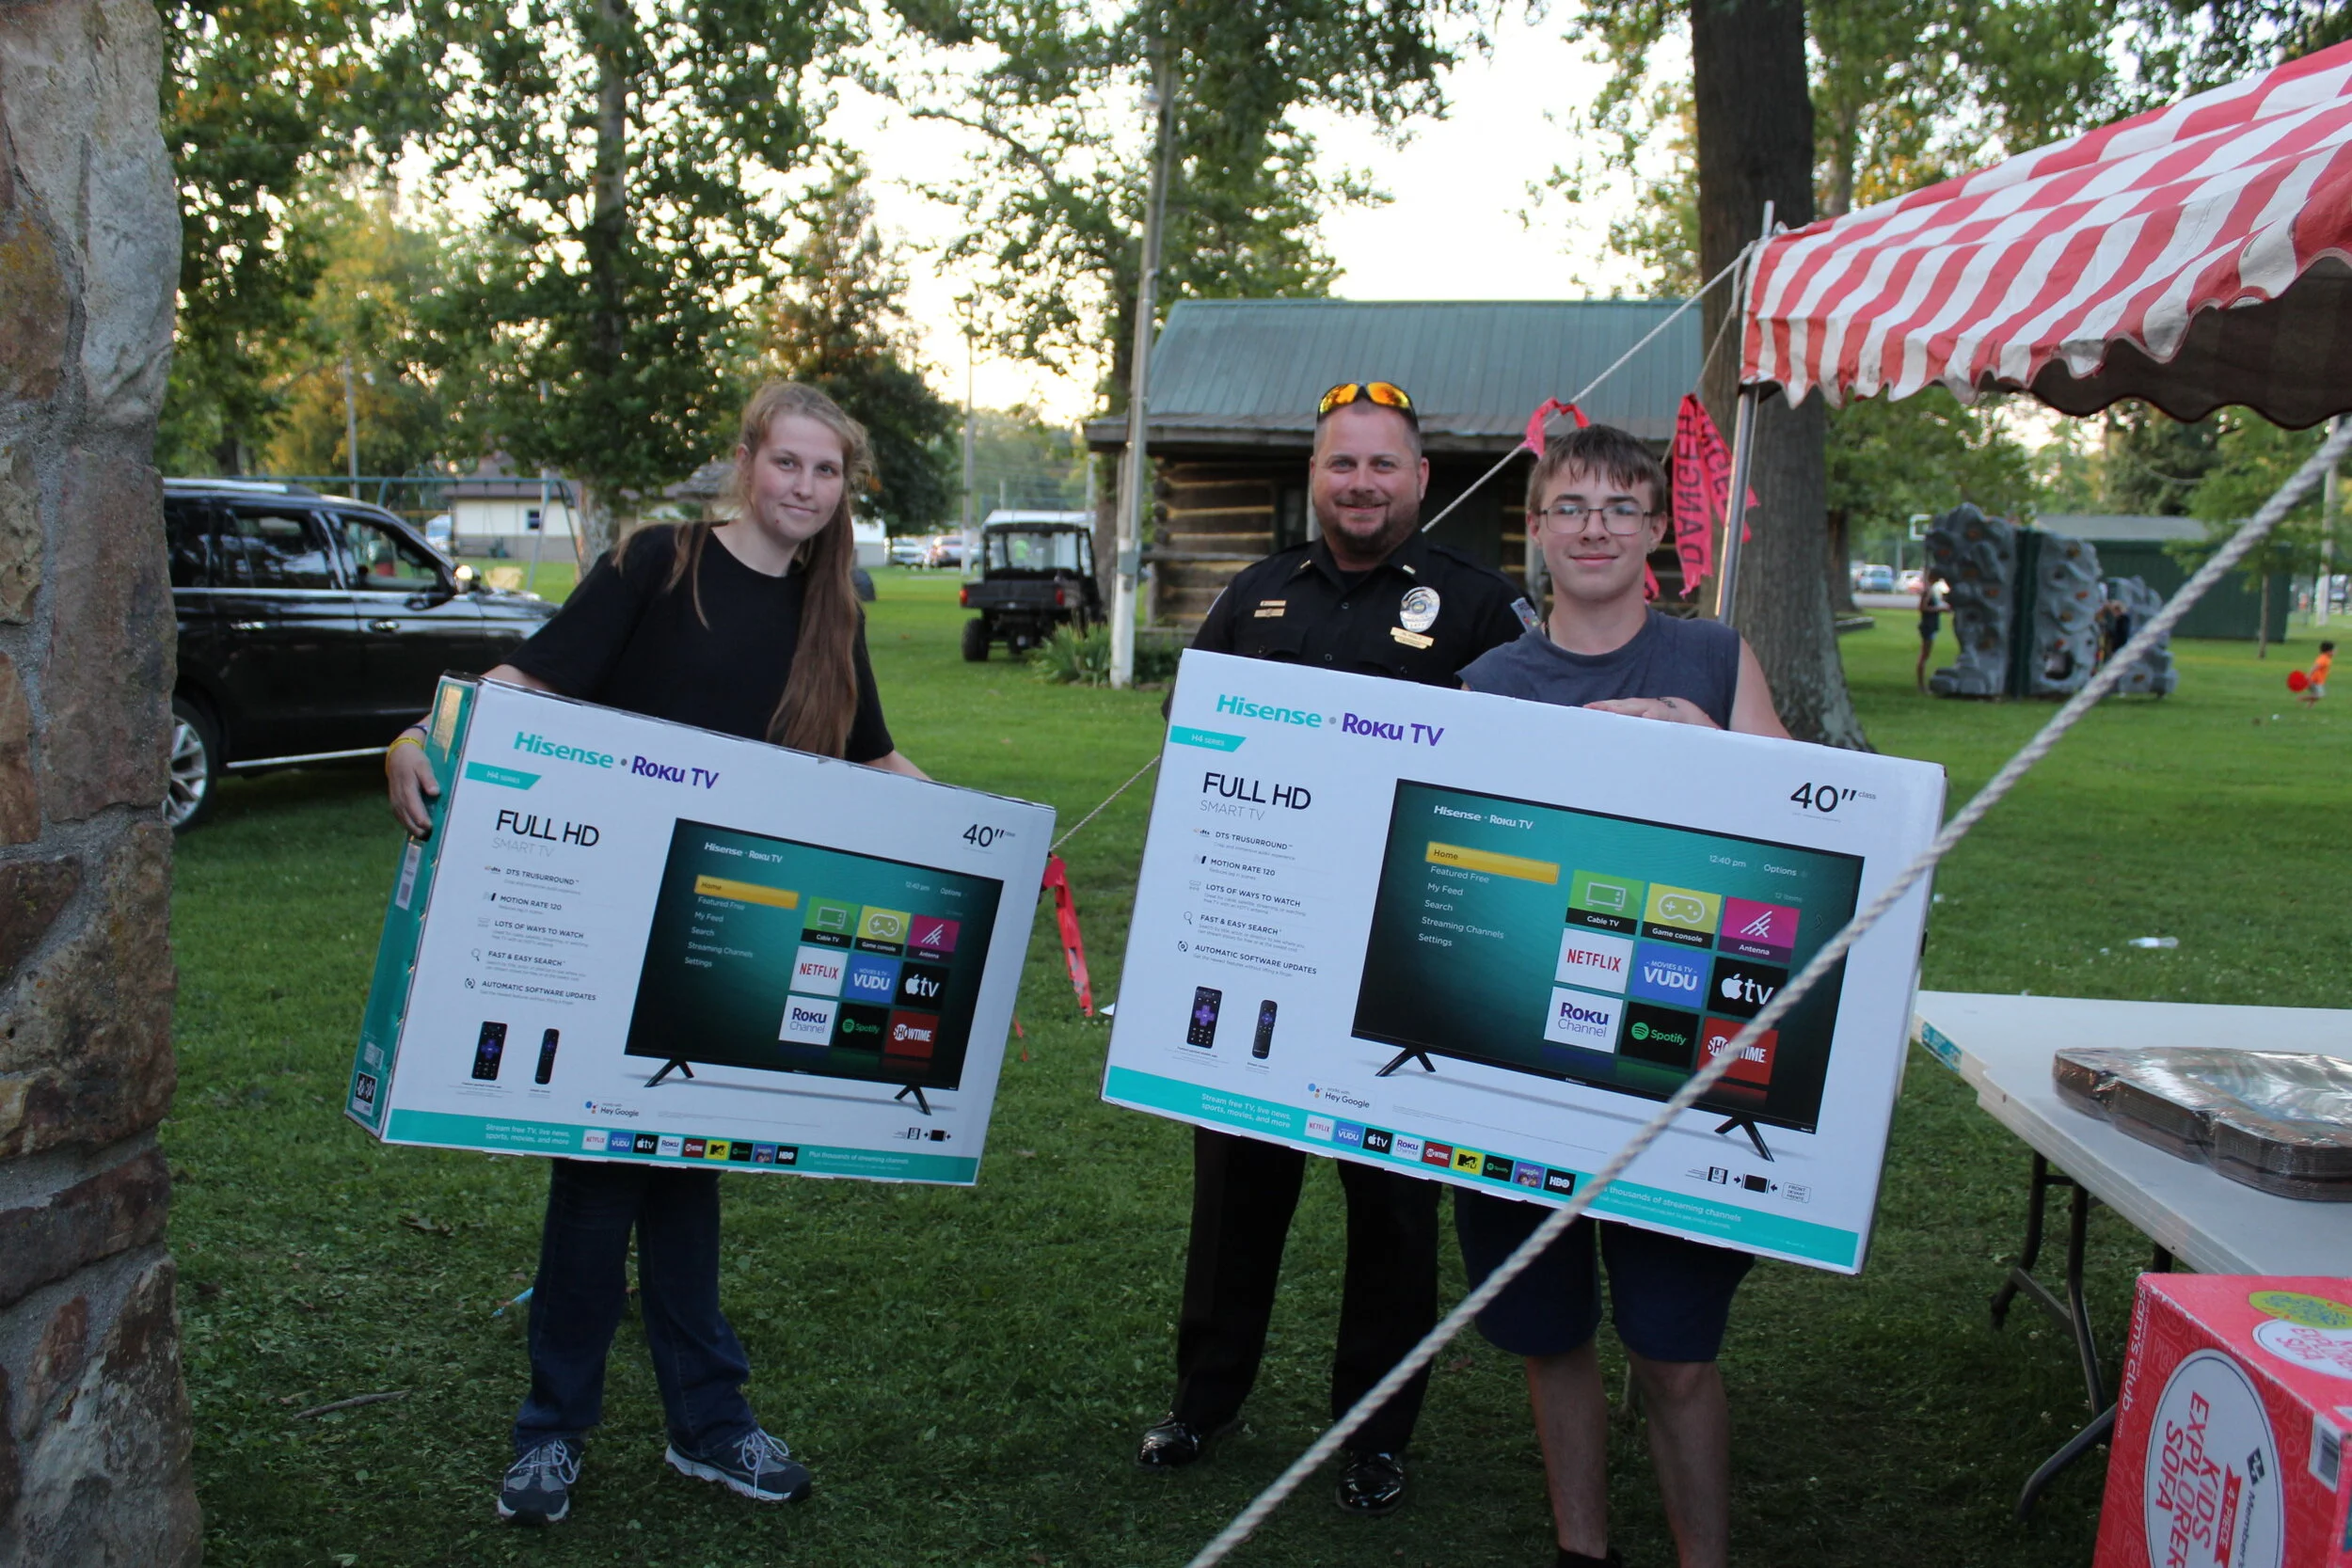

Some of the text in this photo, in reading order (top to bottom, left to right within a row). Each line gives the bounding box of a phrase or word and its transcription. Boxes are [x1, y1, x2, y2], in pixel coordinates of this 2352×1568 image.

[1216, 694, 1444, 746] Hisense Roku TV
[514, 732, 719, 789] Hisense Roku TV
[1202, 771, 1311, 810] FULL HD
[1200, 800, 1264, 821] SMART TV
[1434, 805, 1481, 821] Hisense
[1518, 819, 1534, 830] TV
[496, 810, 599, 847] FULL HD
[491, 837, 555, 858] SMART TV
[705, 842, 783, 863] Hisense TV
[1435, 849, 1458, 860] Home
[1211, 859, 1240, 869] MOTION
[1242, 864, 1261, 874] RATE
[1709, 855, 1746, 868] 12:40 pm
[506, 868, 519, 877] DTS
[1430, 866, 1489, 883] Featured Free
[1763, 863, 1797, 877] Options
[1206, 884, 1224, 893] LOTS
[1239, 890, 1259, 899] WAYS
[1274, 896, 1300, 908] WATCH
[1428, 883, 1463, 895] My Feed
[500, 895, 528, 905] MOTION
[531, 900, 548, 909] RATE
[698, 896, 729, 908] Featured
[1424, 900, 1454, 911] Search
[1200, 914, 1218, 924] FAST
[1227, 919, 1247, 929] EASY
[1248, 924, 1278, 935] SEARCH
[1422, 916, 1504, 939] Streaming Channels
[1587, 915, 1620, 927] Cable TV
[495, 920, 512, 928] LOTS
[527, 925, 546, 933] WAYS
[560, 930, 584, 939] WATCH
[691, 927, 715, 936] Search
[1652, 927, 1703, 942] Game console
[1419, 933, 1453, 946] Settings
[488, 950, 506, 958] FAST
[534, 958, 562, 966] SEARCH
[1739, 944, 1770, 956] Antenna
[685, 957, 712, 968] Settings
[1195, 944, 1238, 958] AUTOMATIC
[1240, 953, 1281, 967] SOFTWARE
[1283, 962, 1317, 974] UPDATES
[1566, 949, 1621, 972] NETFLIX
[1651, 960, 1677, 970] MOVIES
[800, 962, 839, 979] NETFLIX
[1644, 966, 1697, 990] VUDU
[853, 974, 890, 990] VUDU
[920, 977, 939, 997] tv
[482, 981, 523, 991] AUTOMATIC
[525, 987, 564, 996] SOFTWARE
[565, 991, 596, 1001] UPDATES
[1745, 978, 1773, 1006] tv
[791, 1007, 827, 1023] Roku
[1560, 1002, 1609, 1025] Roku
[789, 1021, 825, 1034] Channel
[855, 1023, 881, 1034] Spotify
[894, 1023, 931, 1041] SHOWTIME
[1558, 1019, 1607, 1037] Channel
[1651, 1029, 1686, 1046] Spotify
[1202, 1093, 1227, 1105] Stream
[1229, 1099, 1243, 1108] free
[1257, 1104, 1269, 1115] live
[1325, 1091, 1370, 1109] Hey Google
[600, 1107, 639, 1117] Hey Google
[1256, 1115, 1269, 1124] and
[1271, 1119, 1291, 1128] more
[1309, 1120, 1330, 1132] NETFLIX
[644, 1139, 654, 1149] tv
[1338, 1131, 1359, 1141] VUDU
[1375, 1134, 1388, 1148] tv
[778, 1150, 794, 1160] HBO
[1549, 1176, 1570, 1188] HBO
[1610, 1186, 1651, 1203] thousands
[1662, 1198, 1704, 1214] streaming
[1705, 1208, 1741, 1222] channels
[2155, 1419, 2183, 1512] SOFA
[2220, 1486, 2234, 1549] 4-PIECE
